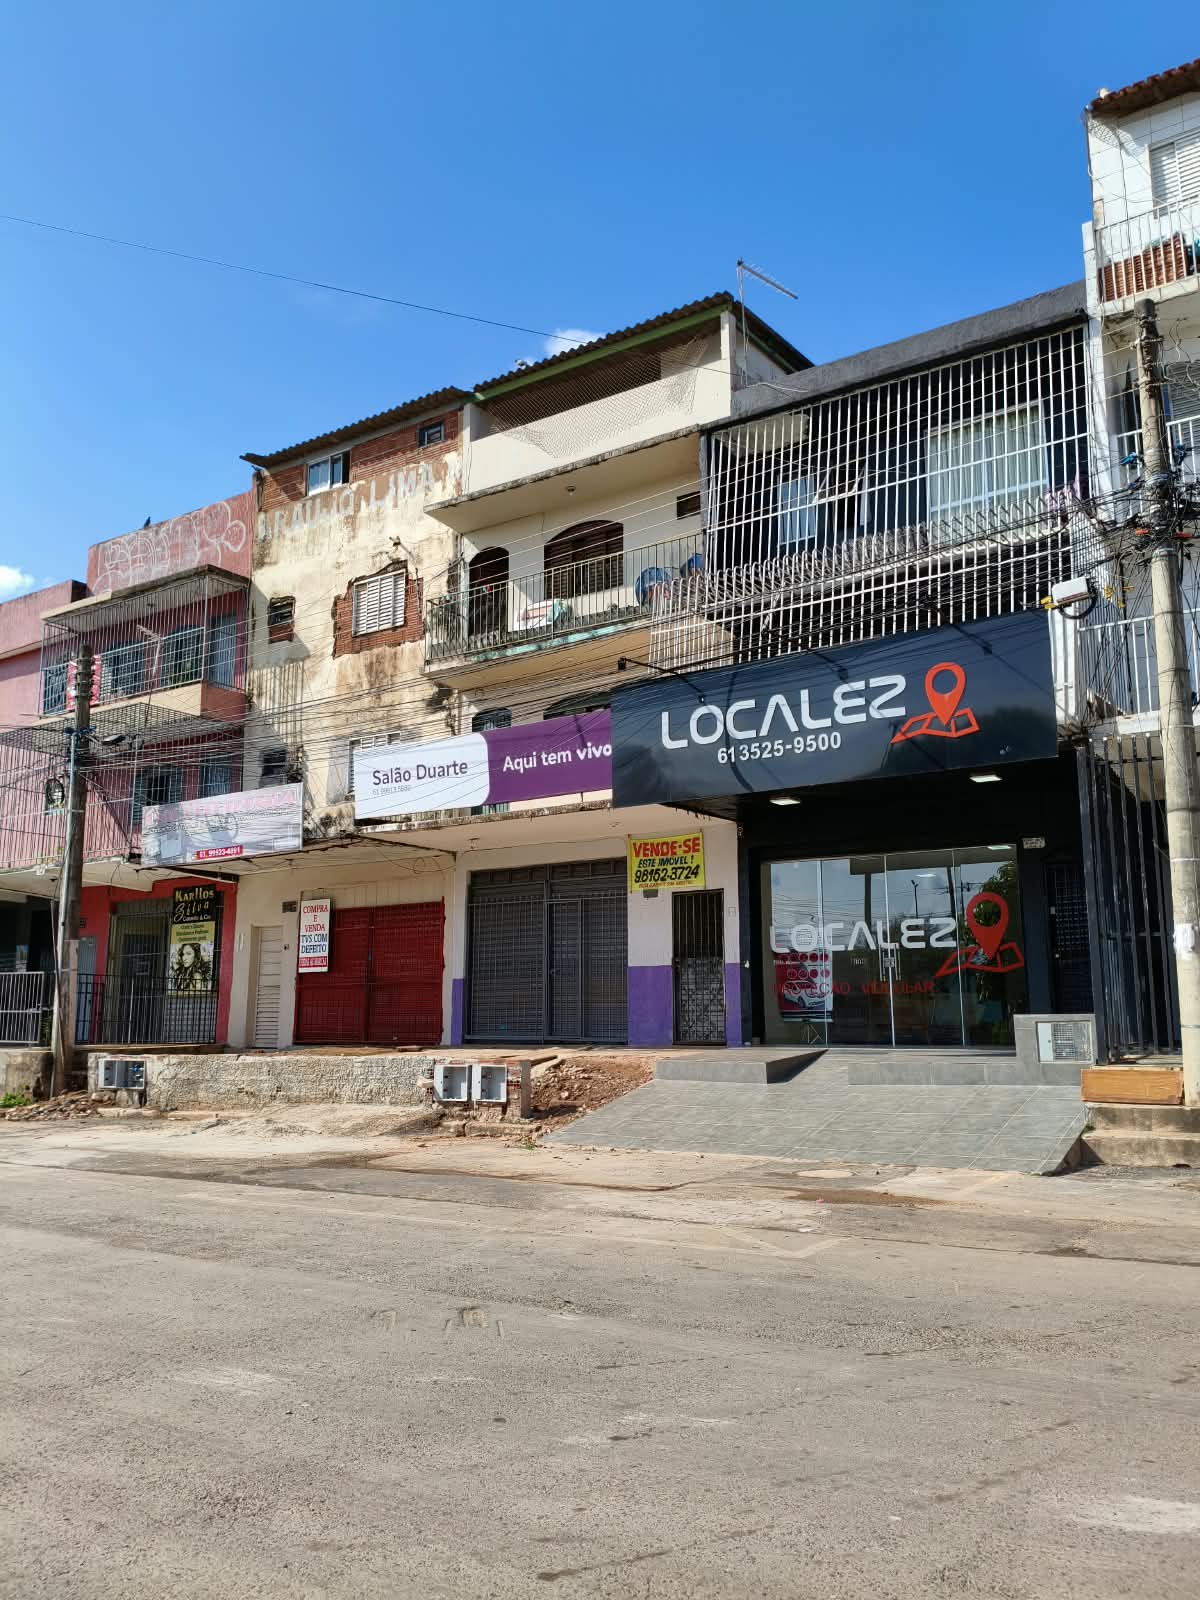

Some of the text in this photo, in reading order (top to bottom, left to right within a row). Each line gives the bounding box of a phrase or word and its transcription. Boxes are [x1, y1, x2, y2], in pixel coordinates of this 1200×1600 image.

[661, 674, 906, 749] LOCALEZ
[502, 742, 612, 774] Aqui tem vivo
[717, 731, 842, 764] 61 3525-9500
[372, 760, 468, 786] Salão Duarte
[633, 837, 701, 858] VENDE-SE
[638, 858, 657, 868] ESTE
[305, 924, 325, 932] VENDA
[313, 914, 318, 922] E
[769, 917, 957, 953] LOCALEZ
[301, 944, 327, 953] DEFEITO
